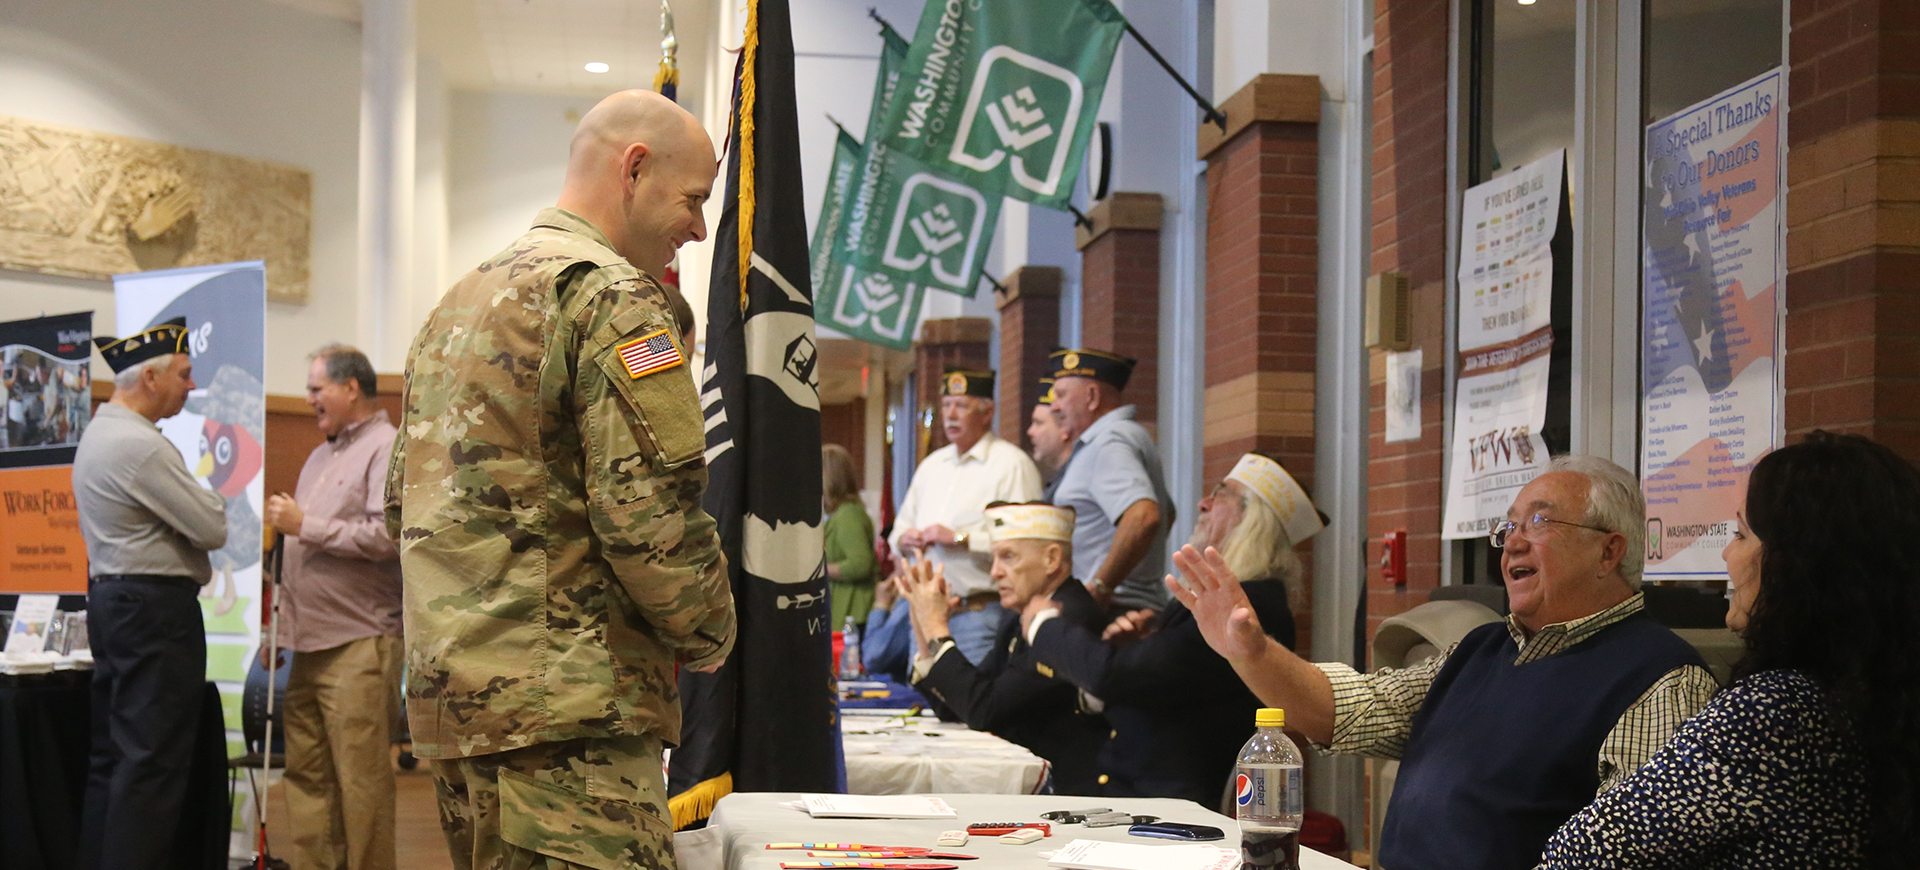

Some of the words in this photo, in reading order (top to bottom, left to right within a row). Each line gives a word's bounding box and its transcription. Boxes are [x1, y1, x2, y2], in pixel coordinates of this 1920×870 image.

[1665, 110, 1713, 161] Special
[1715, 90, 1772, 134] Thanks
[1678, 160, 1704, 188] Our
[1706, 139, 1760, 178] Donors
[1698, 188, 1720, 208] Valley
[1722, 178, 1757, 200] Veterans
[1666, 524, 1710, 538] WASHINGTON
[1709, 522, 1728, 536] STATE
[1702, 539, 1727, 549] COLLEGE
[1256, 776, 1266, 807] pepsi
